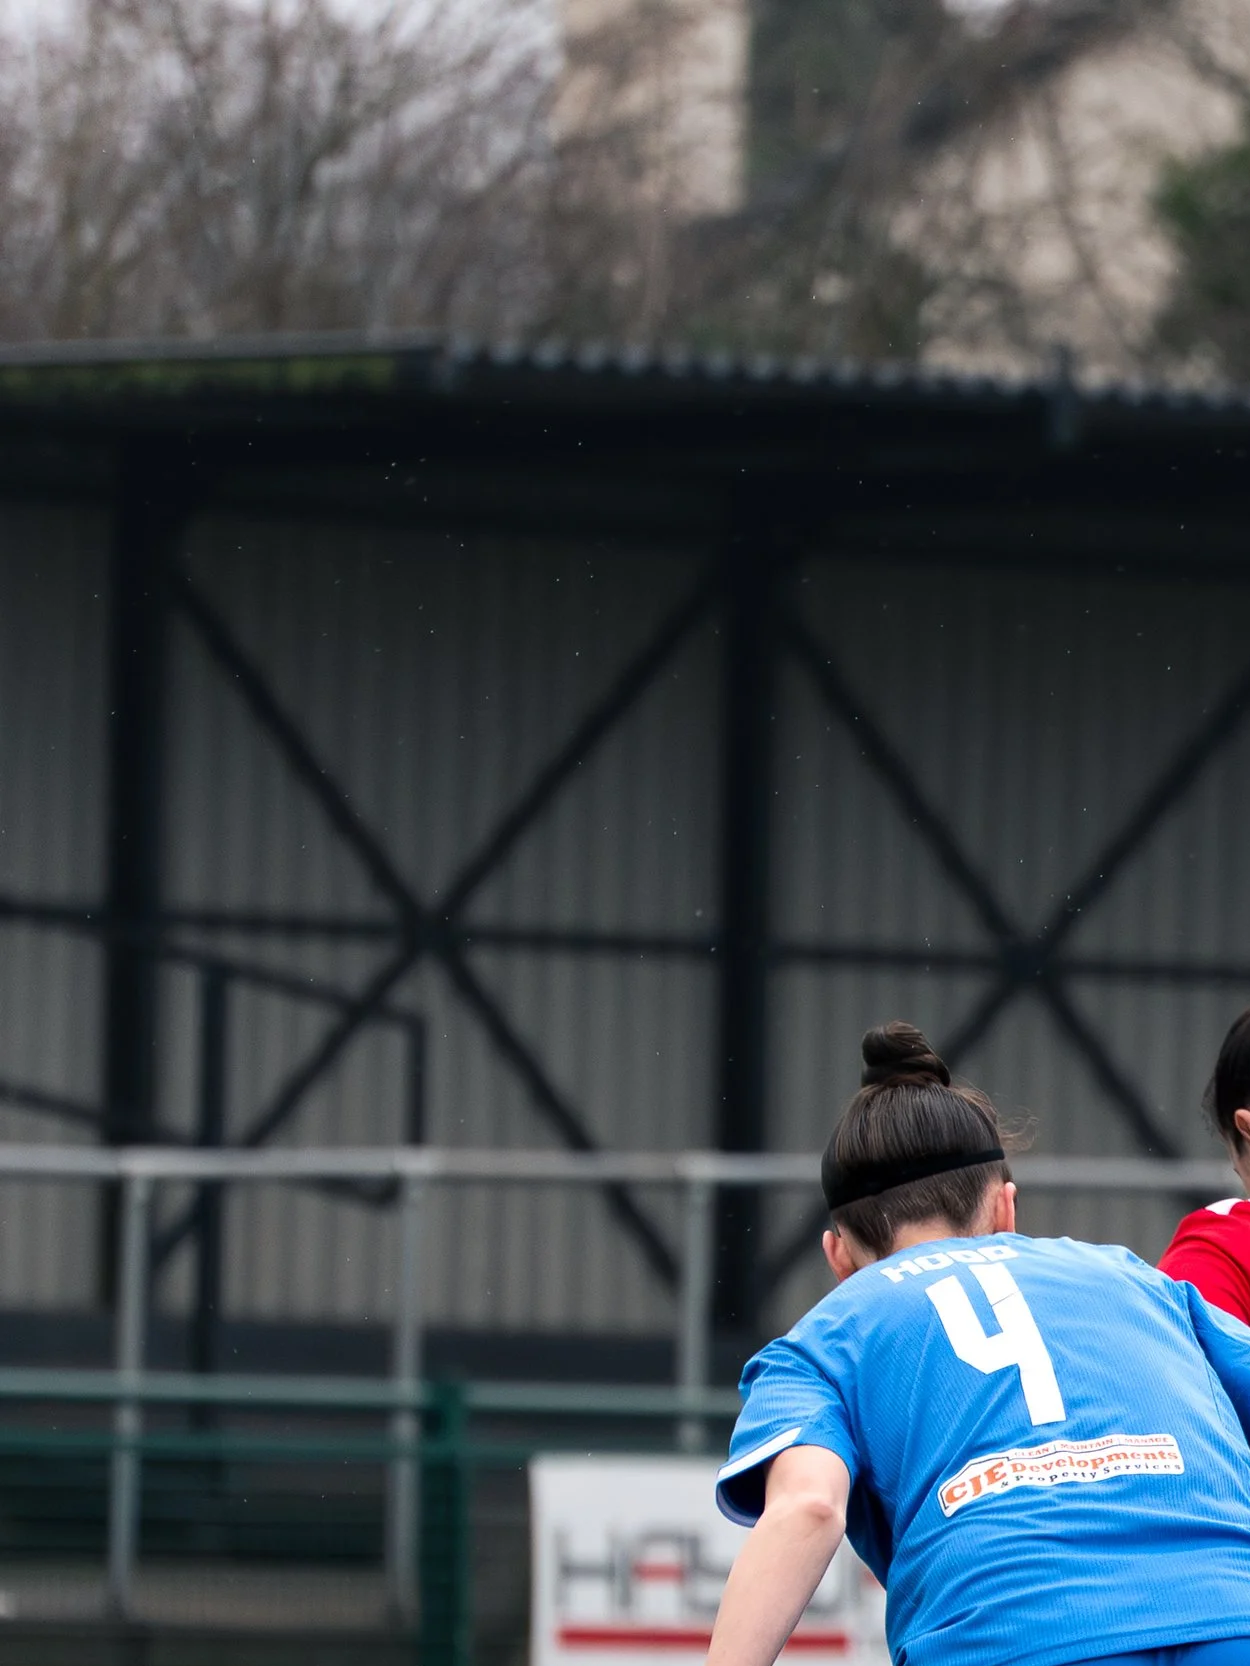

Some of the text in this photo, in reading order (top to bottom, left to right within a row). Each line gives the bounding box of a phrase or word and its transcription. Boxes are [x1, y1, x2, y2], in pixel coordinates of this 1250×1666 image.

[880, 1245, 1019, 1284] HOOD
[925, 1262, 1066, 1426] 4
[1060, 1438, 1113, 1451] MAINTAIN
[945, 1450, 1179, 1504] CJE Developments
[1014, 1471, 1097, 1483] Property
[1103, 1463, 1182, 1475] Services
